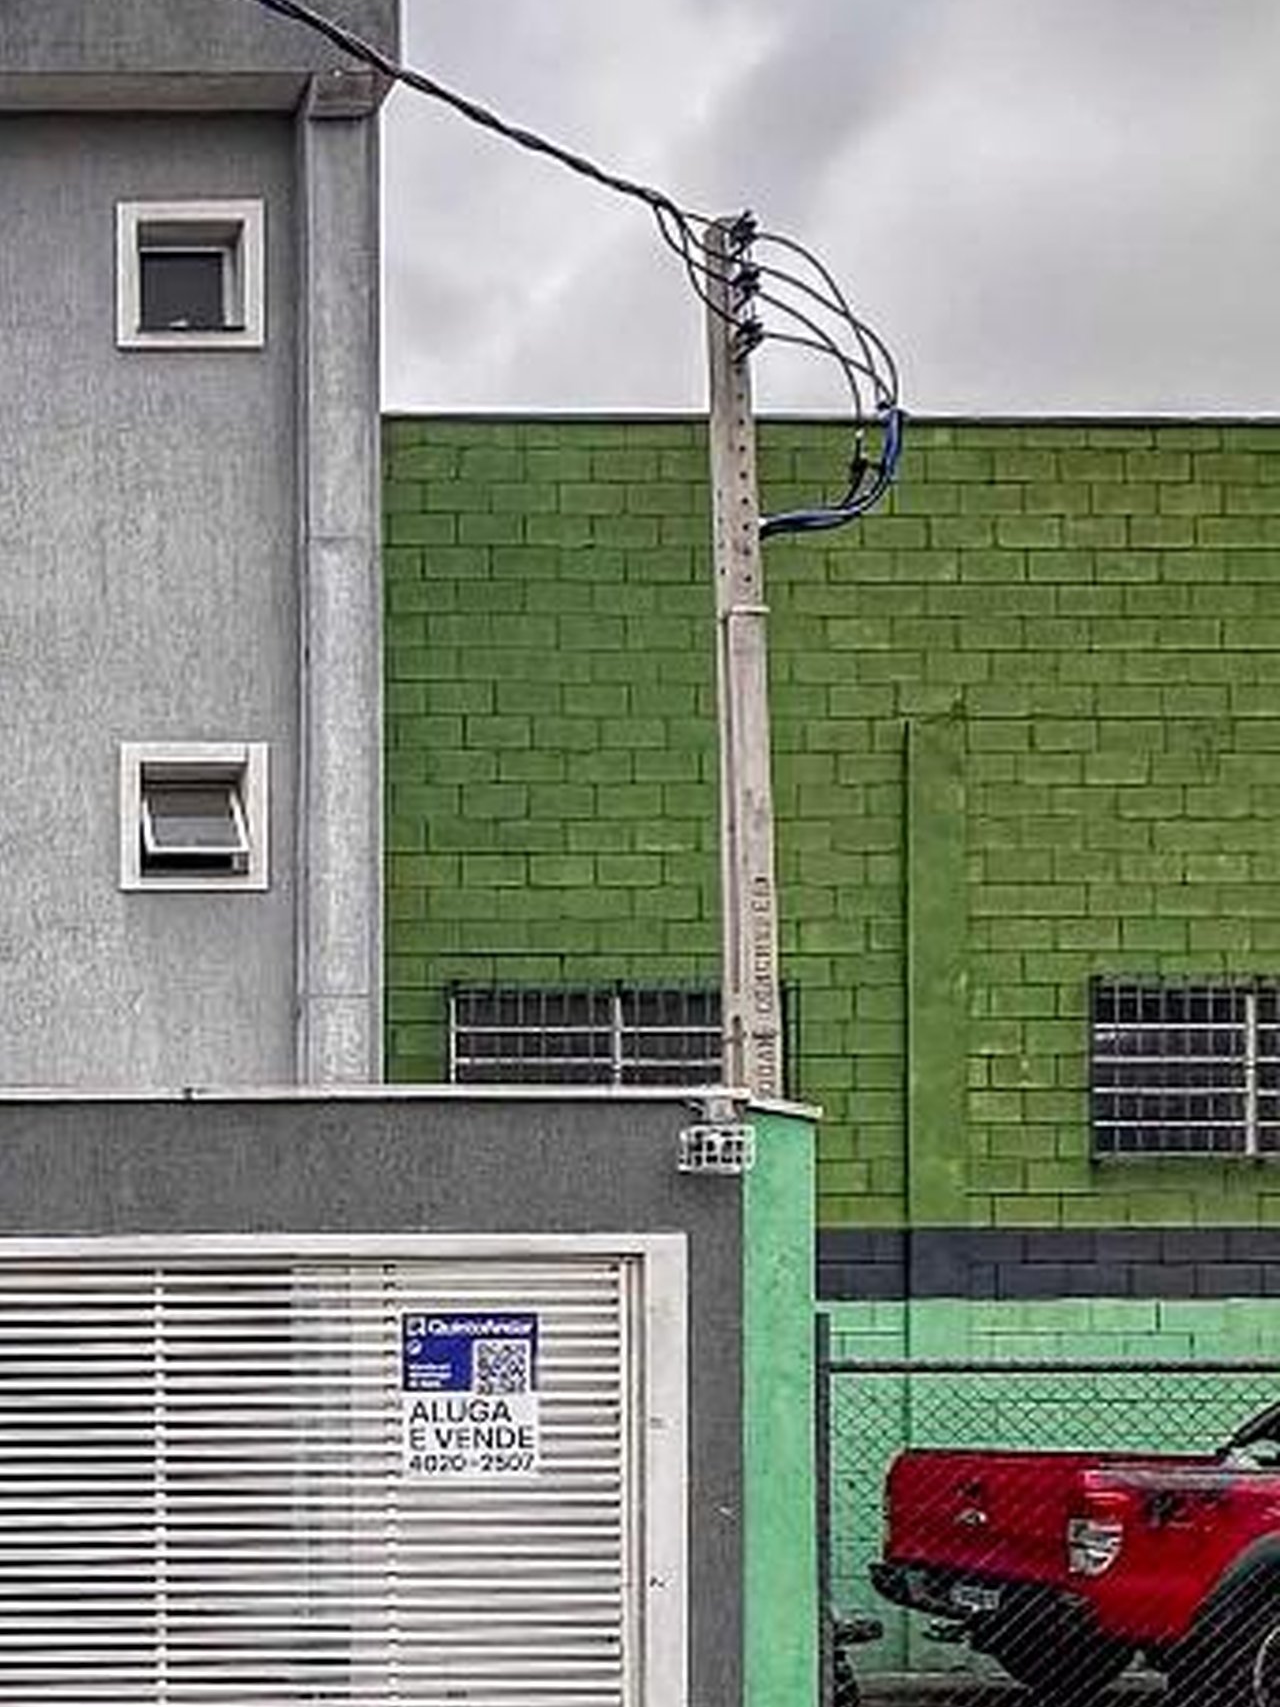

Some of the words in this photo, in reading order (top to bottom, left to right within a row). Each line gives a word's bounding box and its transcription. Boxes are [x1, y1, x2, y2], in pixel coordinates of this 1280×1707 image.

[409, 1400, 512, 1423] ALUGA
[409, 1428, 426, 1451] E
[435, 1426, 534, 1450] VENDE
[409, 1454, 535, 1473] 4020-2507
